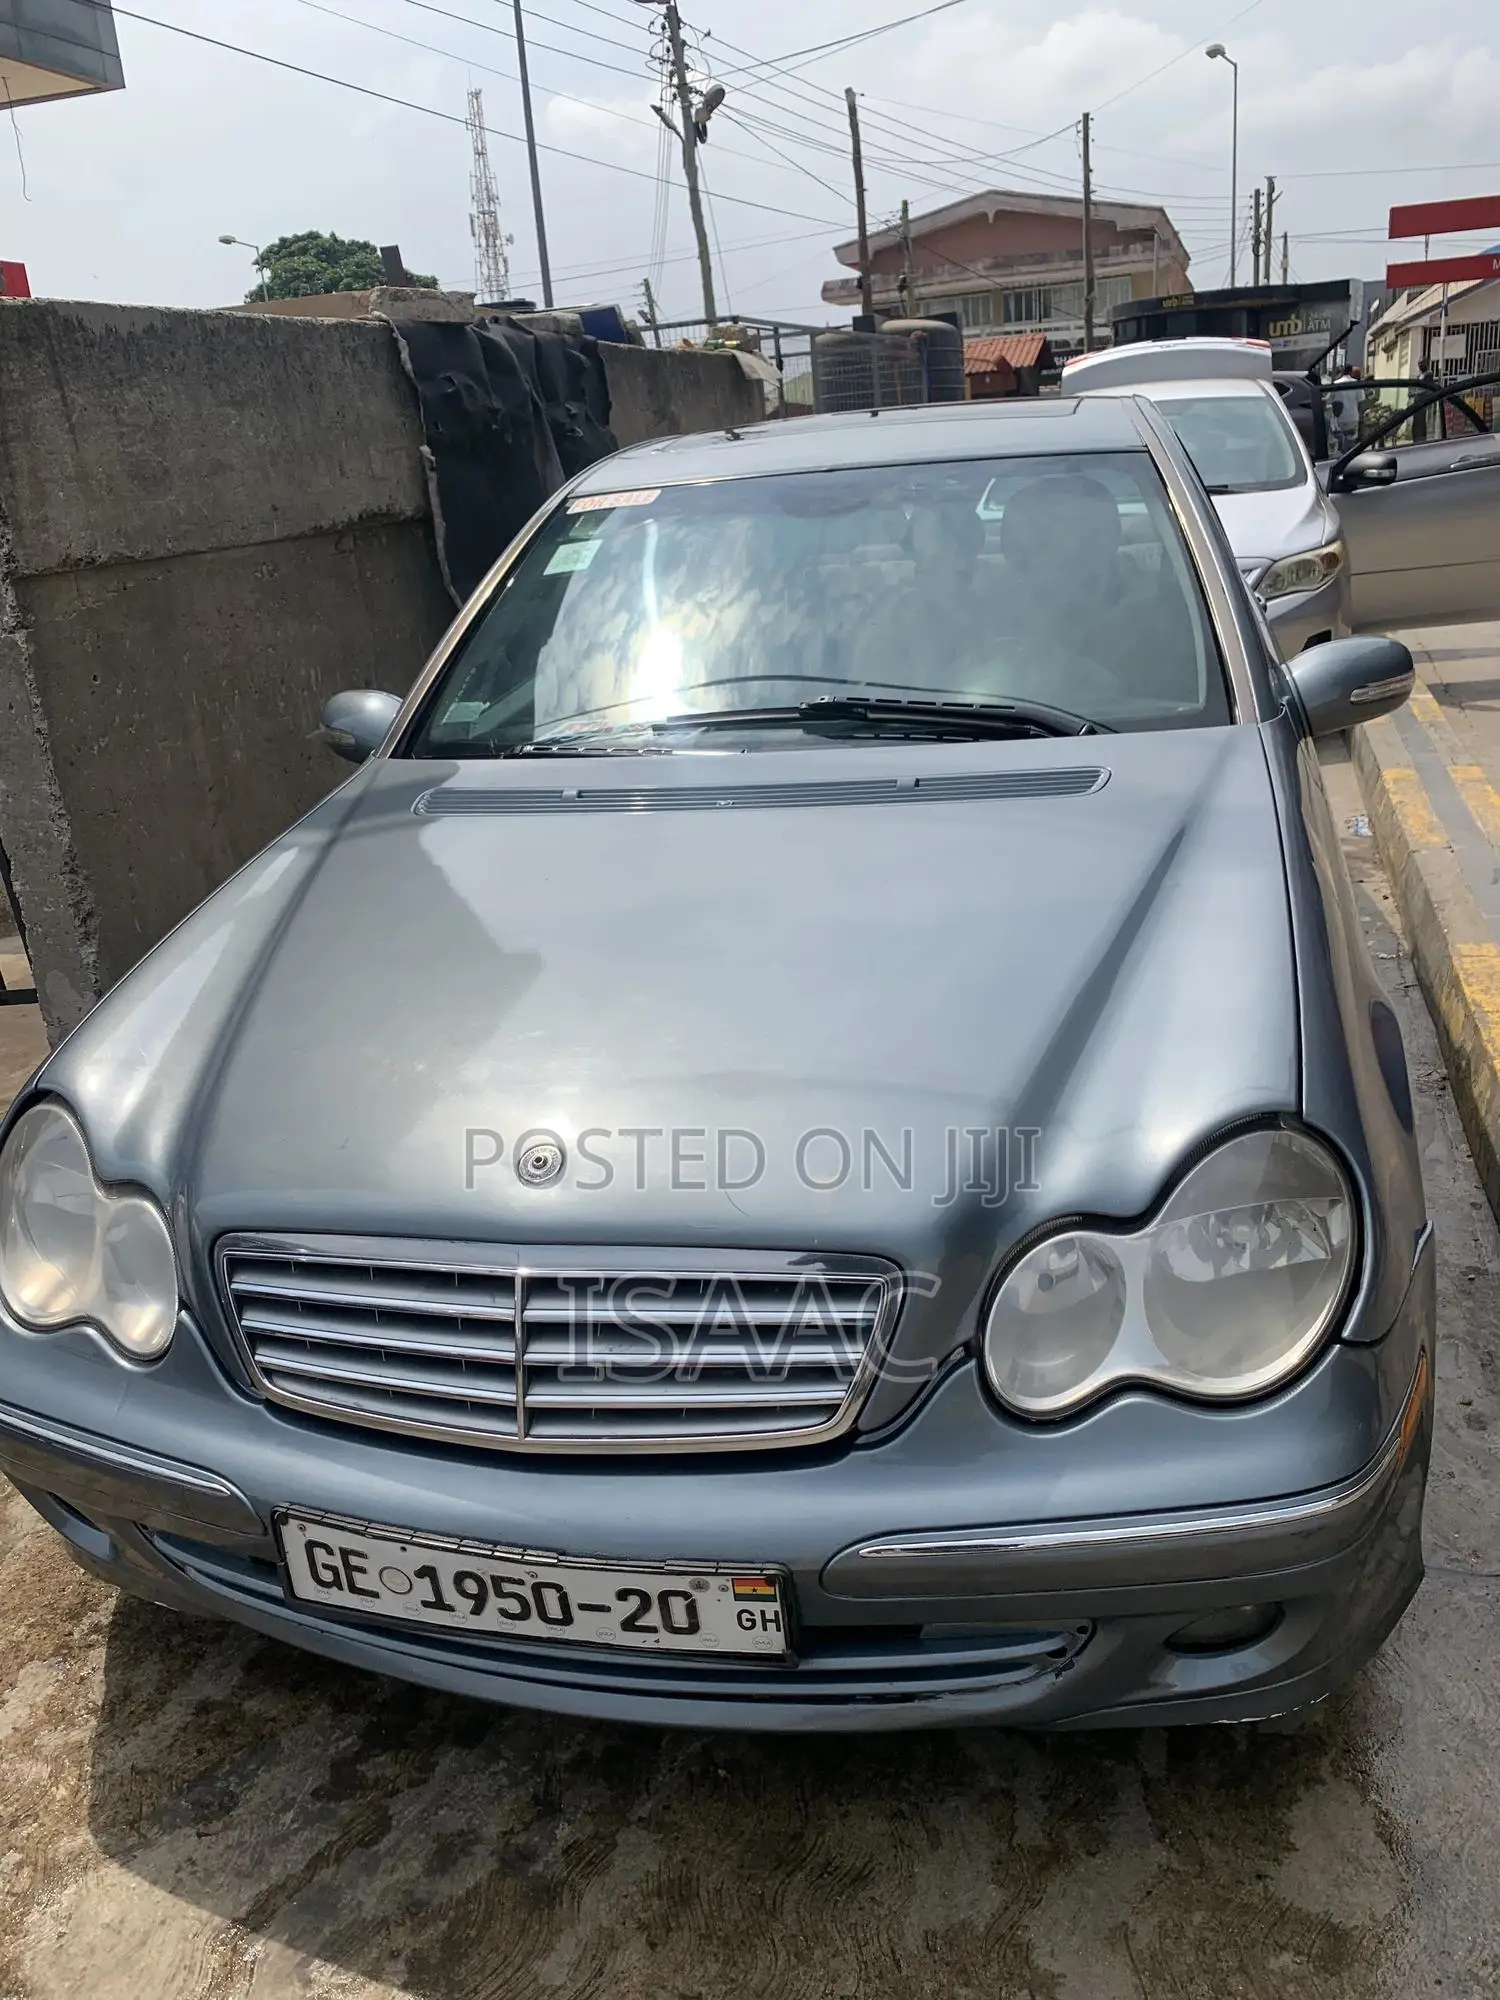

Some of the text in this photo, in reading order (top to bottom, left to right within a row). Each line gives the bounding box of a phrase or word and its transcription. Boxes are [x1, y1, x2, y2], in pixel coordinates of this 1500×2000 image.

[1269, 313, 1302, 337] umb
[1307, 319, 1331, 332] ATM
[304, 1538, 700, 1636] GE 1950-20
[736, 1608, 782, 1633] GH
